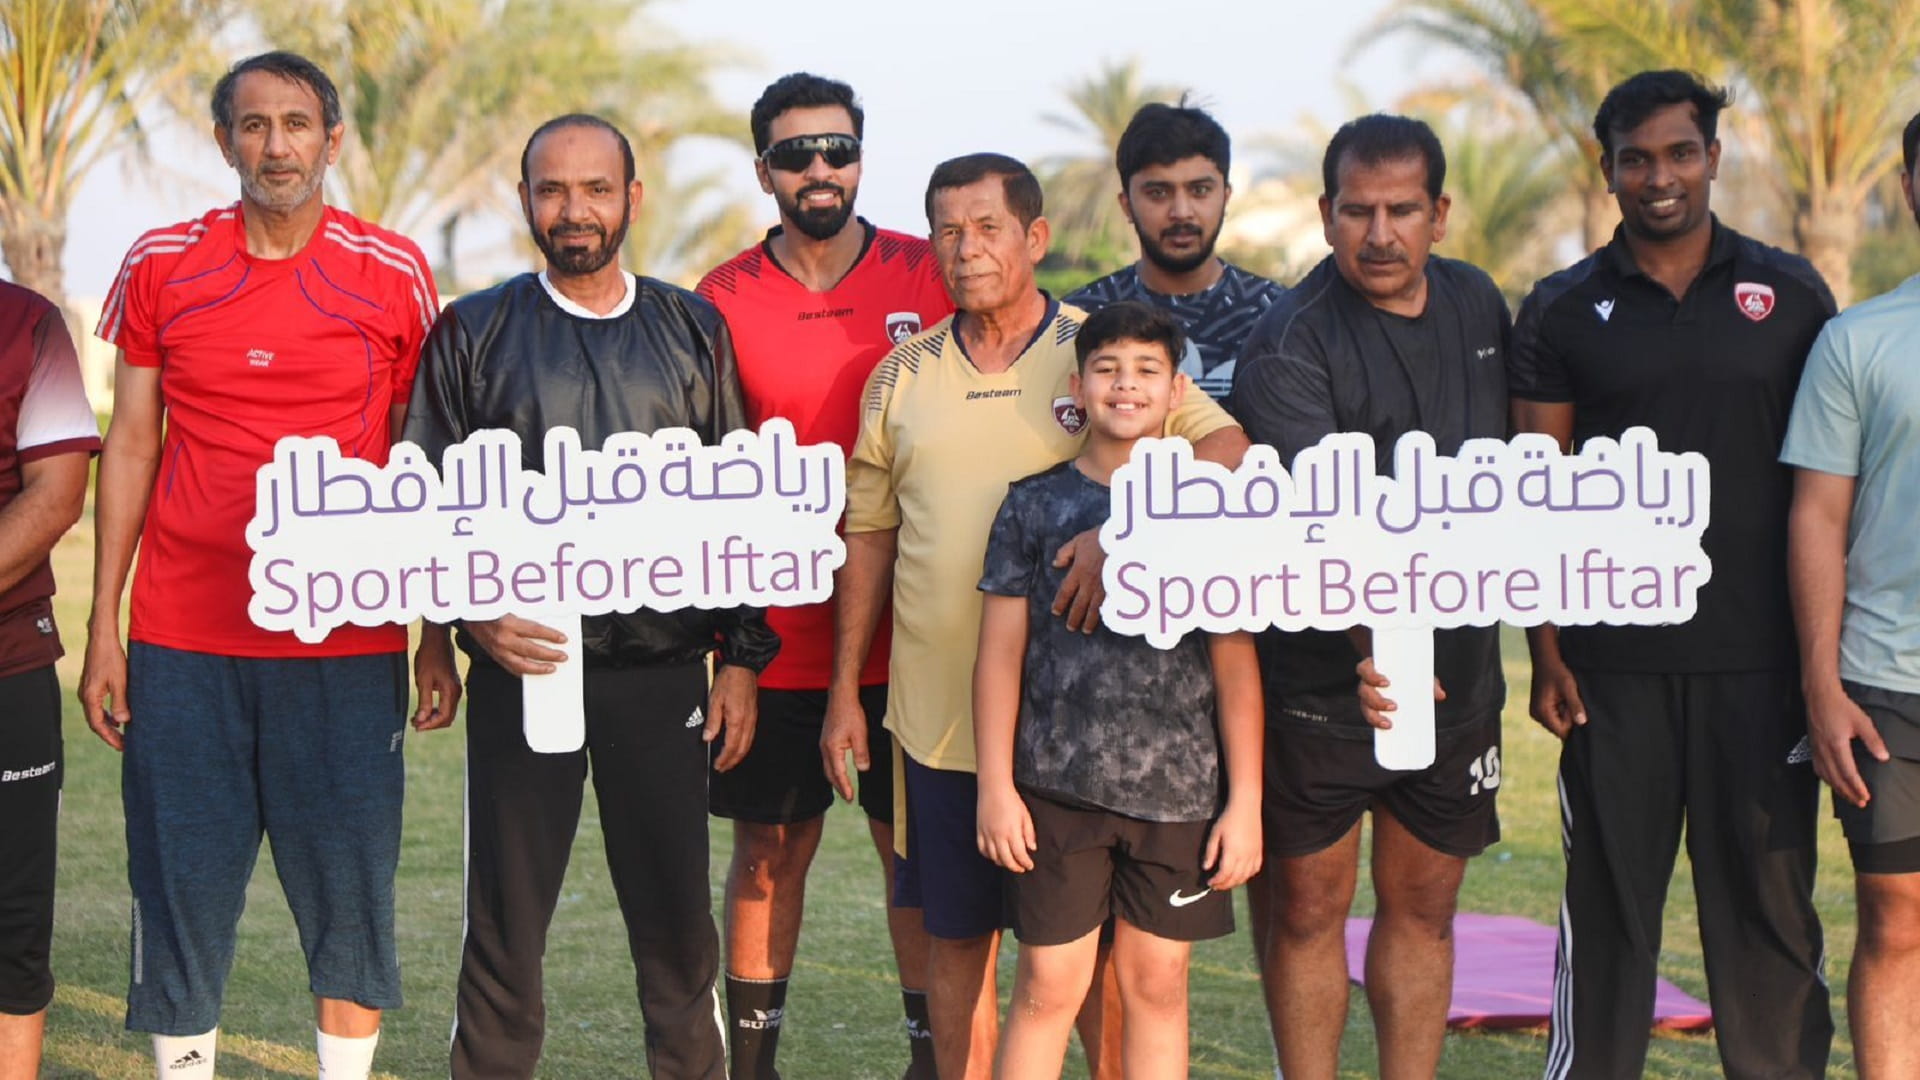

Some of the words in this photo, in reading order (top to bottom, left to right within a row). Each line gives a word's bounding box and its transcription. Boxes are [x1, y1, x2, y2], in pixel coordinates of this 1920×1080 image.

[966, 389, 1022, 400] Besteam
[262, 443, 508, 537] الإفطار
[523, 441, 646, 525] قبل
[660, 433, 831, 514] رياضة
[1115, 449, 1361, 543] الإفطار
[1376, 447, 1503, 533] قبل
[1517, 442, 1695, 528] رياضة
[264, 556, 451, 628] Sport
[467, 543, 683, 607] Before
[702, 535, 833, 595] Iftar
[1116, 561, 1302, 634] Sport
[1319, 552, 1540, 616] Before
[1560, 548, 1697, 610] Iftar
